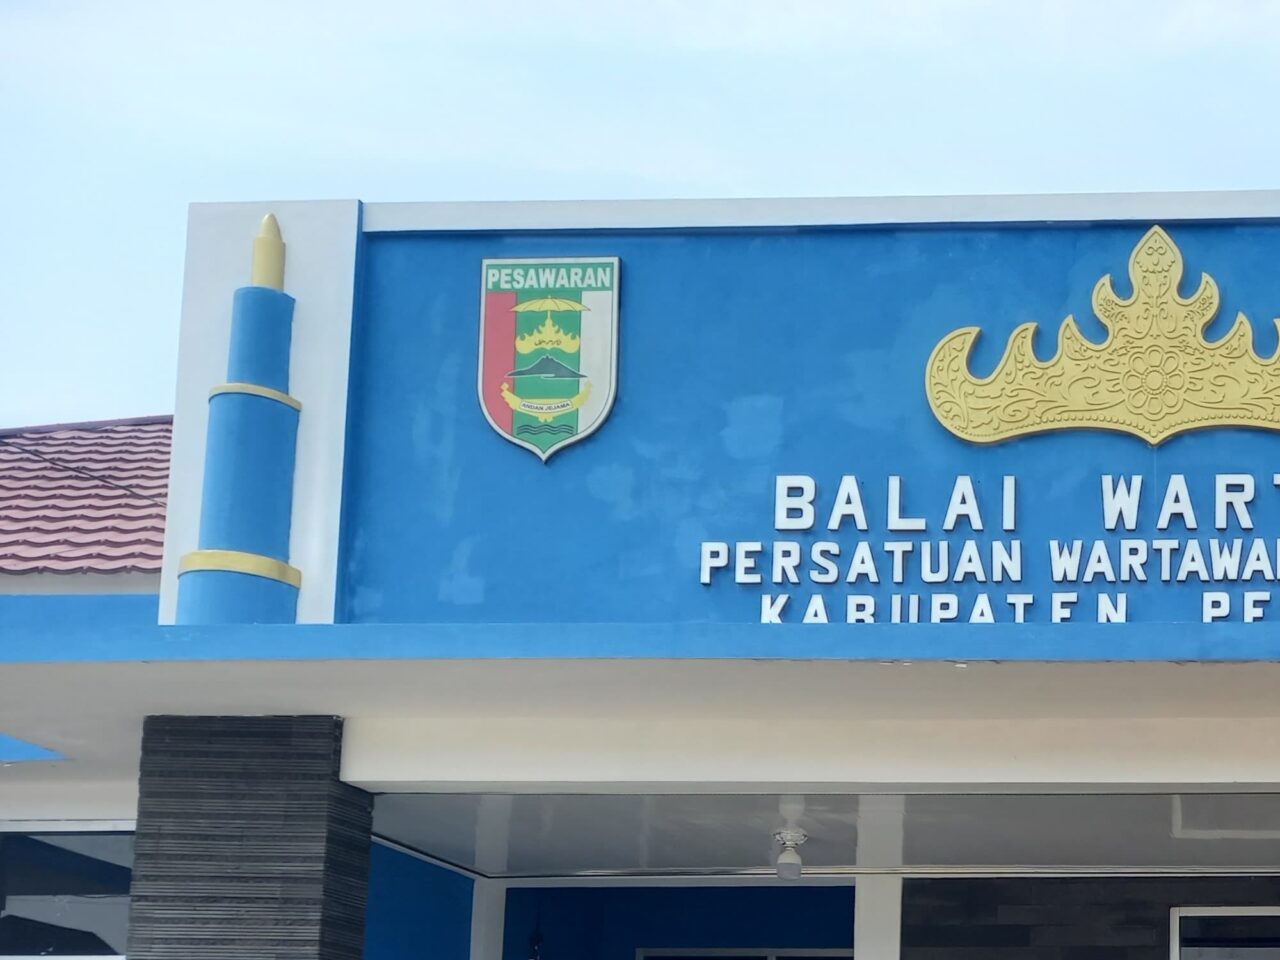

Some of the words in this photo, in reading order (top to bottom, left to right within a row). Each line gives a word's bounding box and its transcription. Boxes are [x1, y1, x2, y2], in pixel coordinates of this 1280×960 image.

[487, 267, 611, 289] PESAWARAN
[775, 475, 1015, 531] BALAI
[700, 540, 1022, 584] PERSATUAN
